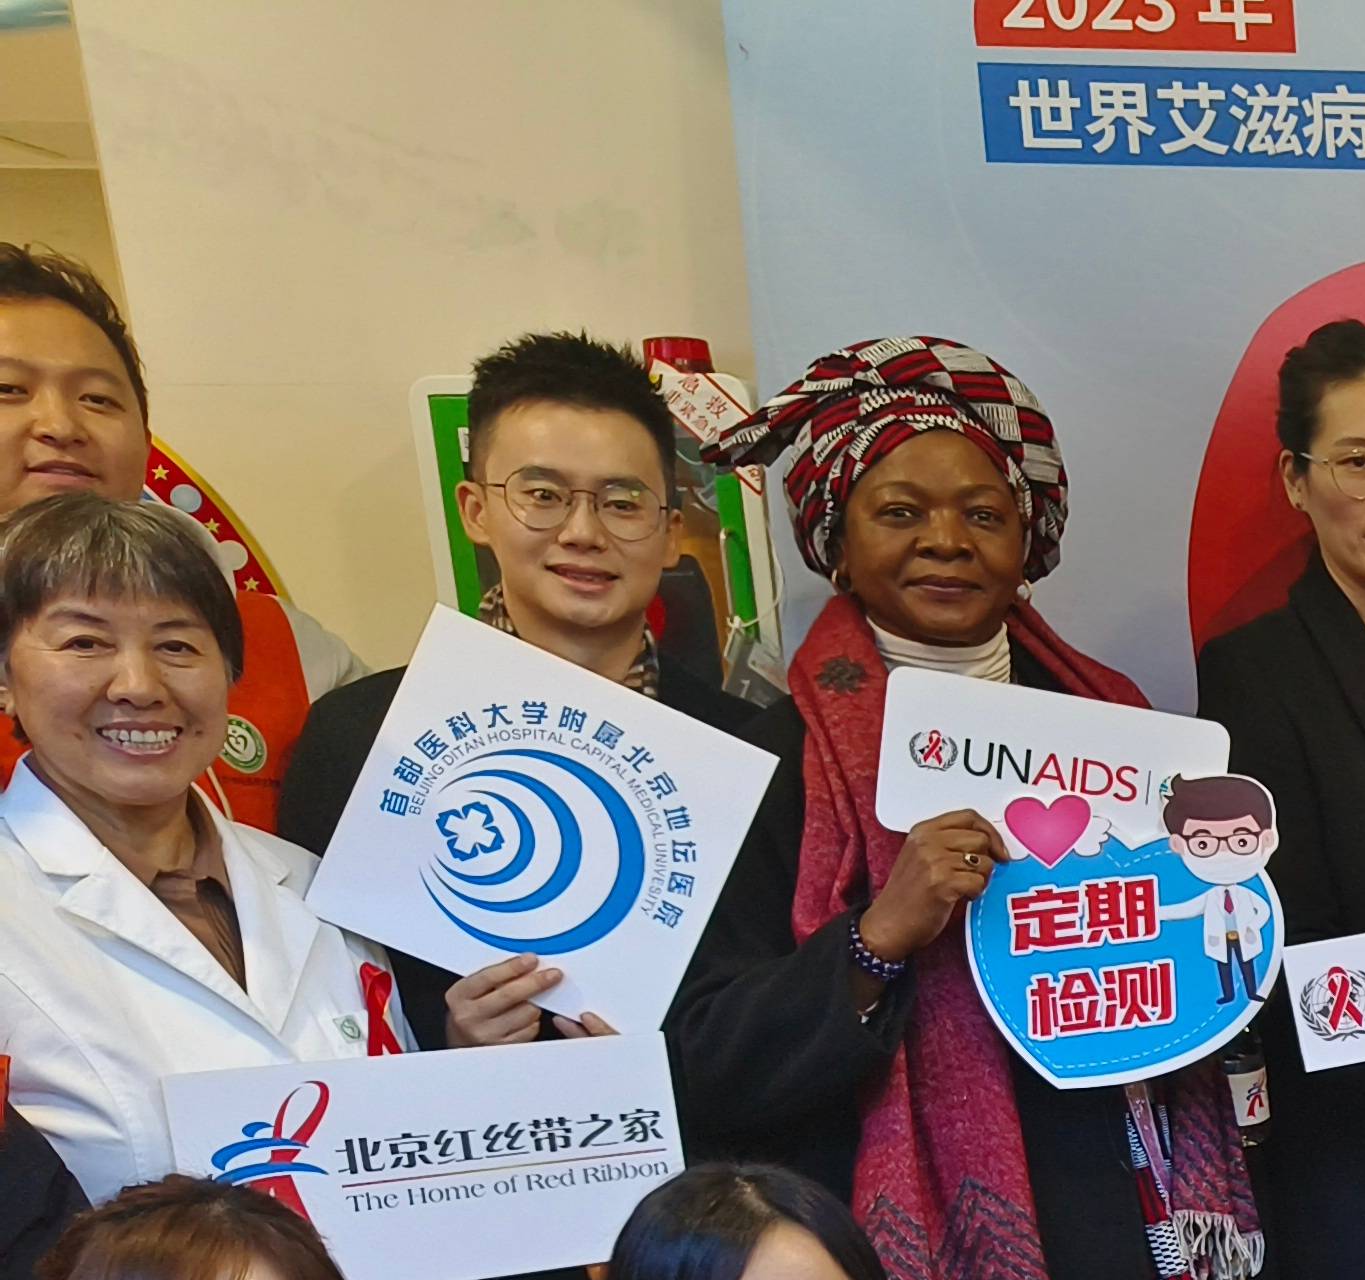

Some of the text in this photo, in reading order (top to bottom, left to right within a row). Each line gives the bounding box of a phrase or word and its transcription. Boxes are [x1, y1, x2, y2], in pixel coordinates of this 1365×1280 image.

[409, 763, 445, 815] BEIJING
[442, 736, 486, 770] DITAN
[487, 728, 566, 746] HOSPITAL
[570, 737, 627, 780] CAPITAL
[627, 778, 664, 840] MEDICAL
[962, 738, 1139, 804] UNAIDS
[379, 701, 696, 929] 首都医科大学附属北京地坛医院
[1009, 876, 1160, 952] 定期
[1029, 962, 1173, 1038] 检测
[334, 1108, 665, 1176] 北京红丝带之家
[346, 1156, 670, 1213] The Home of Red Ribbon
